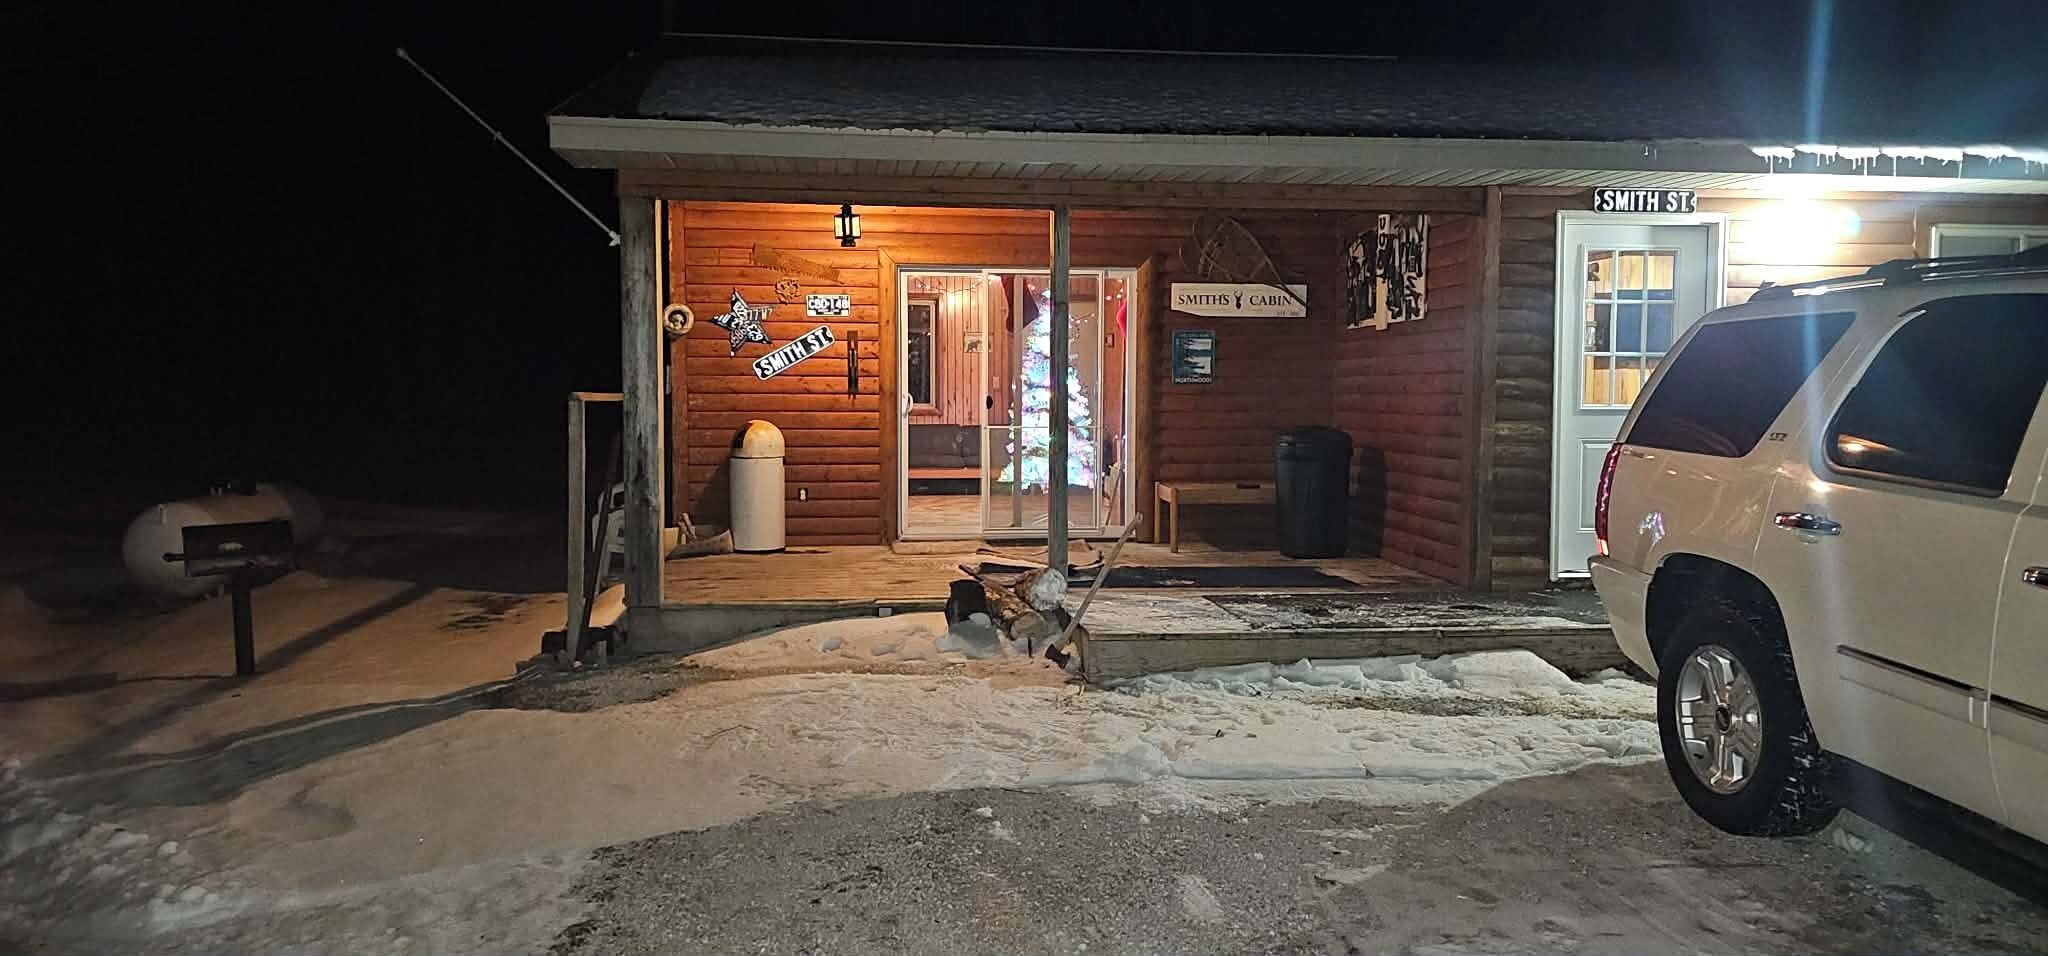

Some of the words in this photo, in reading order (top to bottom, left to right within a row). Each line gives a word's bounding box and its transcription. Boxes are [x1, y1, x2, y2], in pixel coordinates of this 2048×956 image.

[1602, 190, 1659, 212] SMITH
[1666, 191, 1690, 212] ST.
[1178, 293, 1231, 306] SMITH'S
[1249, 294, 1293, 306] CABIN
[760, 341, 807, 375] SMITH
[806, 329, 830, 351] ST.
